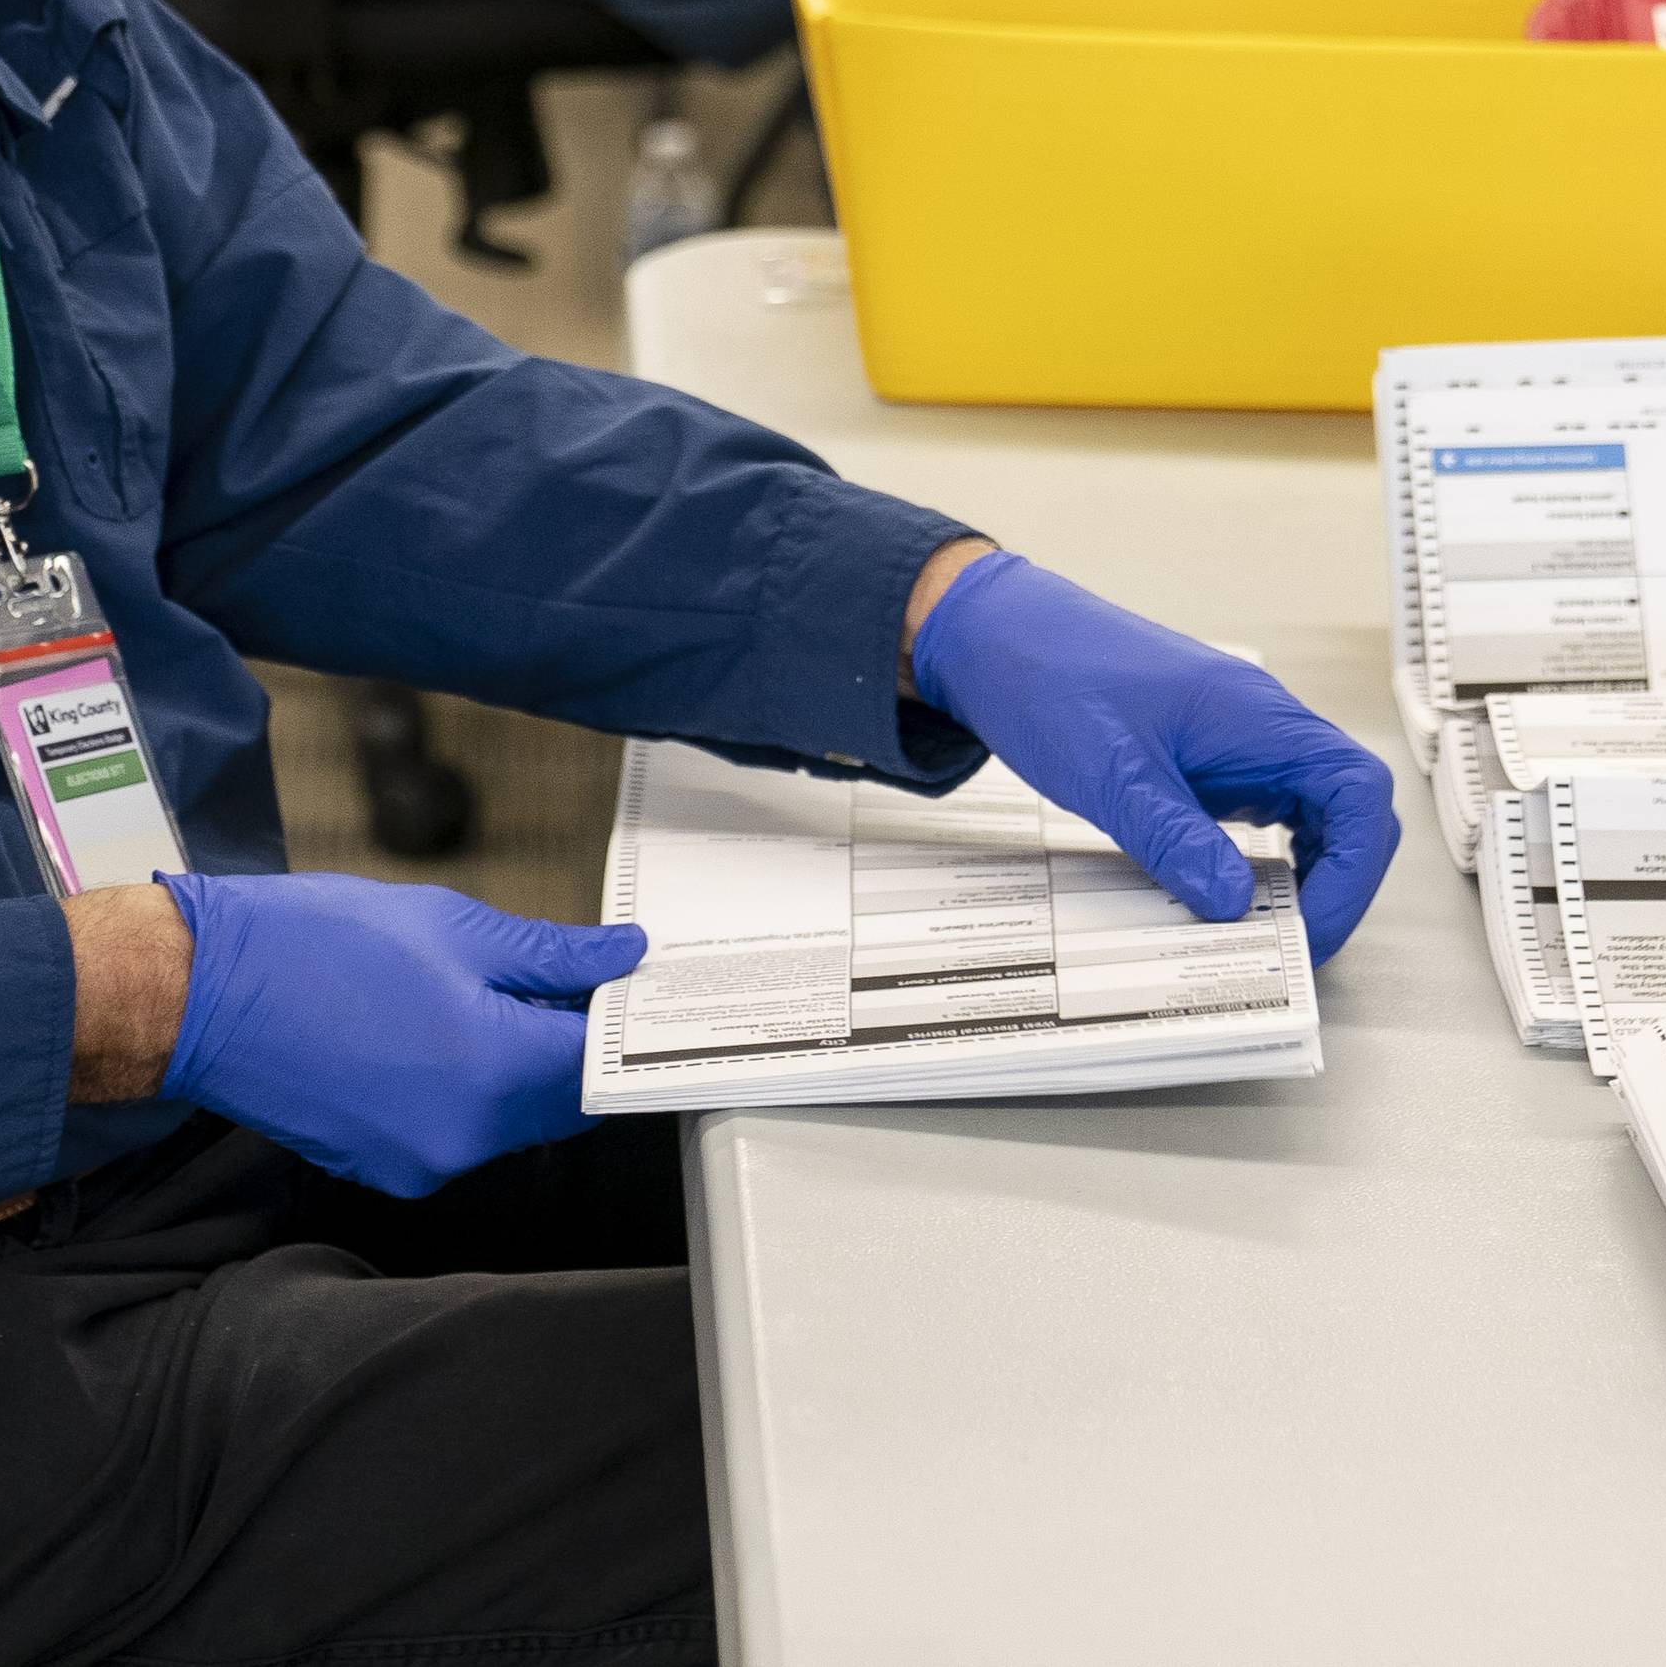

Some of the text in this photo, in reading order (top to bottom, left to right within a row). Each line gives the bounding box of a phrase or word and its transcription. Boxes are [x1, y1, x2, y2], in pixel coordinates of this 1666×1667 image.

[49, 698, 120, 727] King County
[896, 967, 1052, 987] Seattle Municipal Court
[708, 1016, 845, 1032] Seattle Transit Measure
[780, 1021, 846, 1032] Proposition
[905, 1019, 1055, 1040] West Electoral District
[765, 1027, 845, 1040] City of Seattle
[817, 1036, 847, 1047] City
